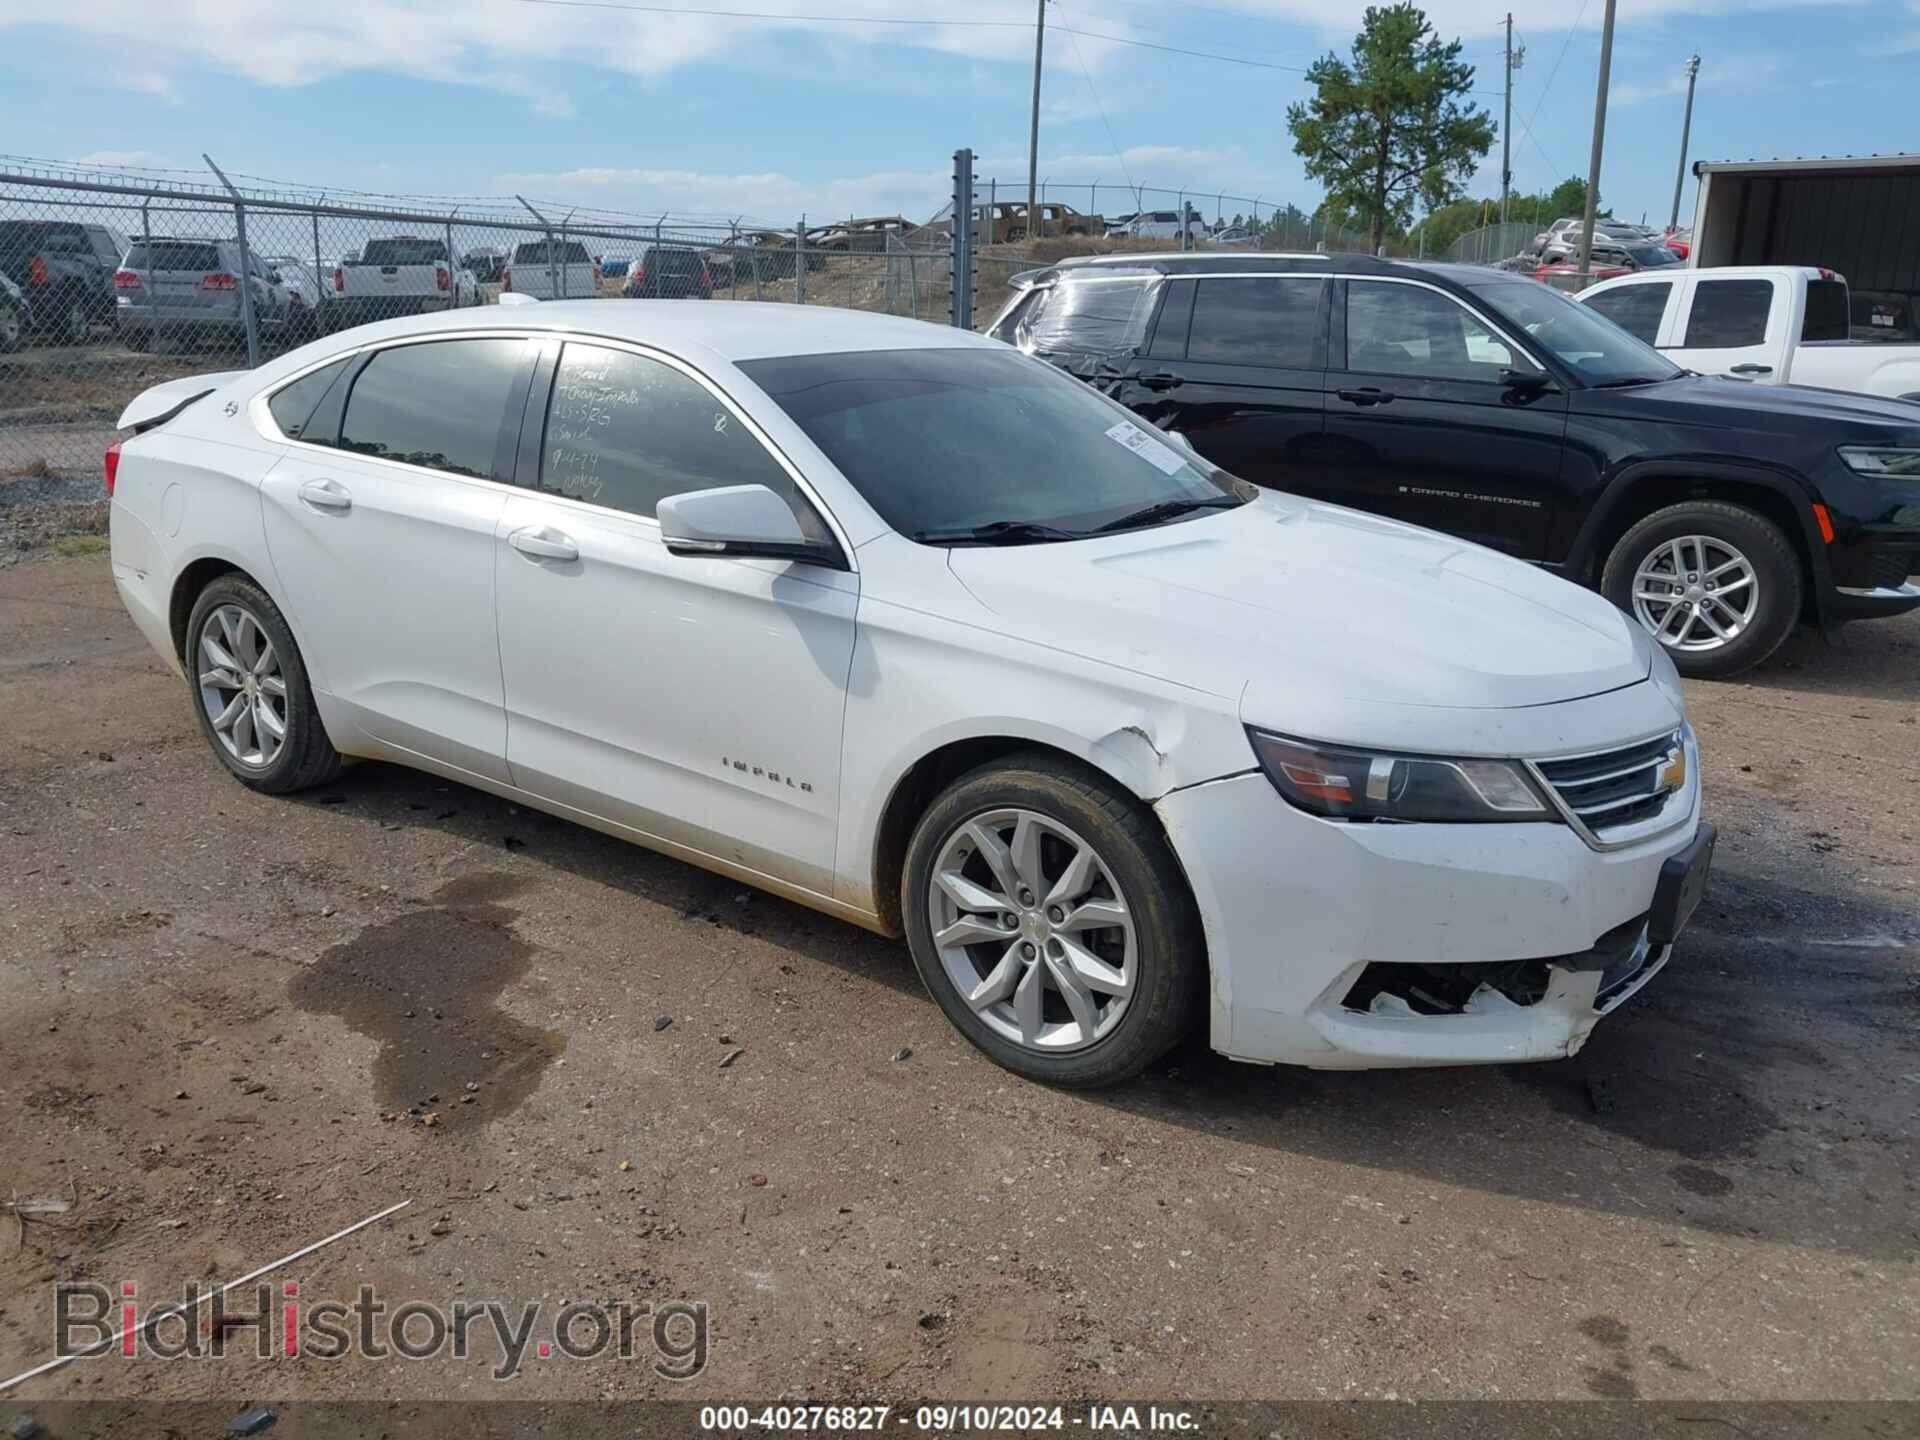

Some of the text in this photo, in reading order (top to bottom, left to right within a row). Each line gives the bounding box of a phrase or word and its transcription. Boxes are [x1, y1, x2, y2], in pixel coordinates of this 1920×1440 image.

[1411, 486, 1542, 508] GRAND CHEROKEE
[722, 756, 813, 793] IMPALA
